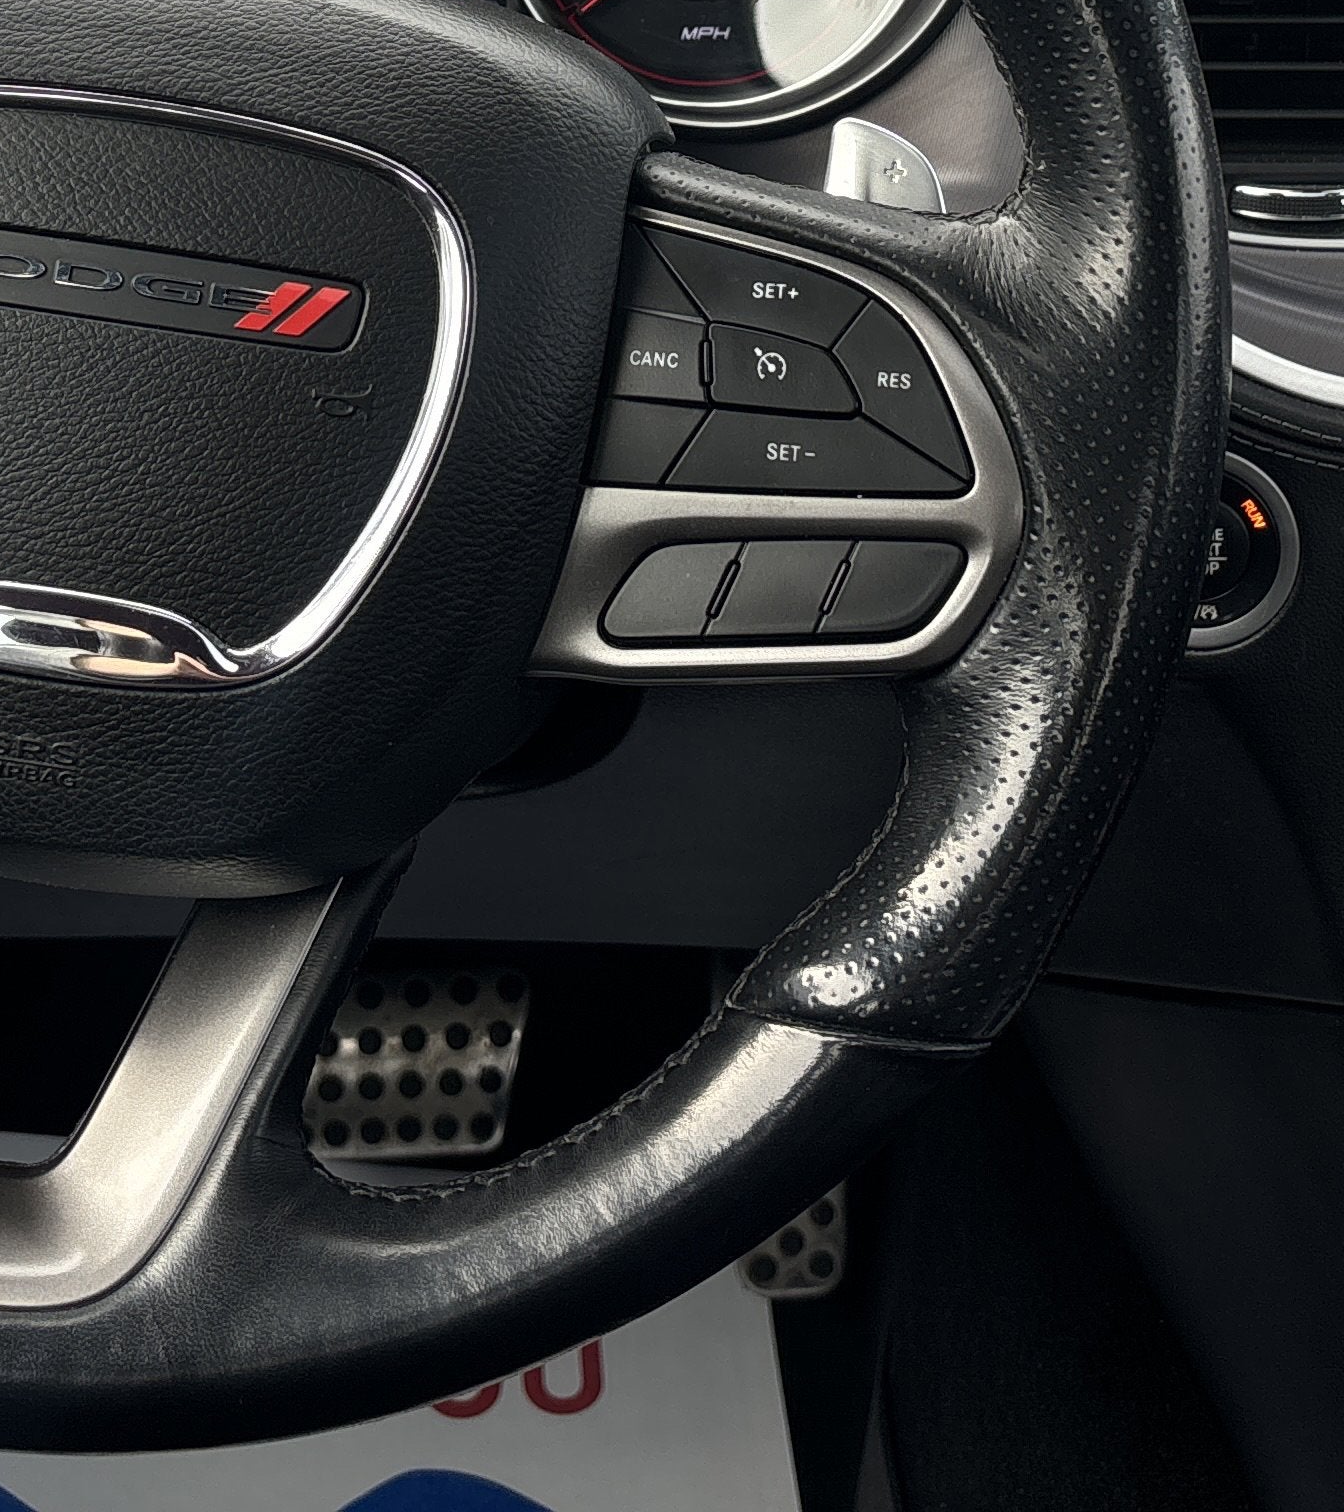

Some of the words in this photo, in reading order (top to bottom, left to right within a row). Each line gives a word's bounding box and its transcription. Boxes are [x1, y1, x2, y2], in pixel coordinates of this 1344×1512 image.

[680, 25, 731, 41] MPH
[629, 350, 680, 369] CANC
[877, 371, 912, 390] RES
[1240, 498, 1267, 530] RUN
